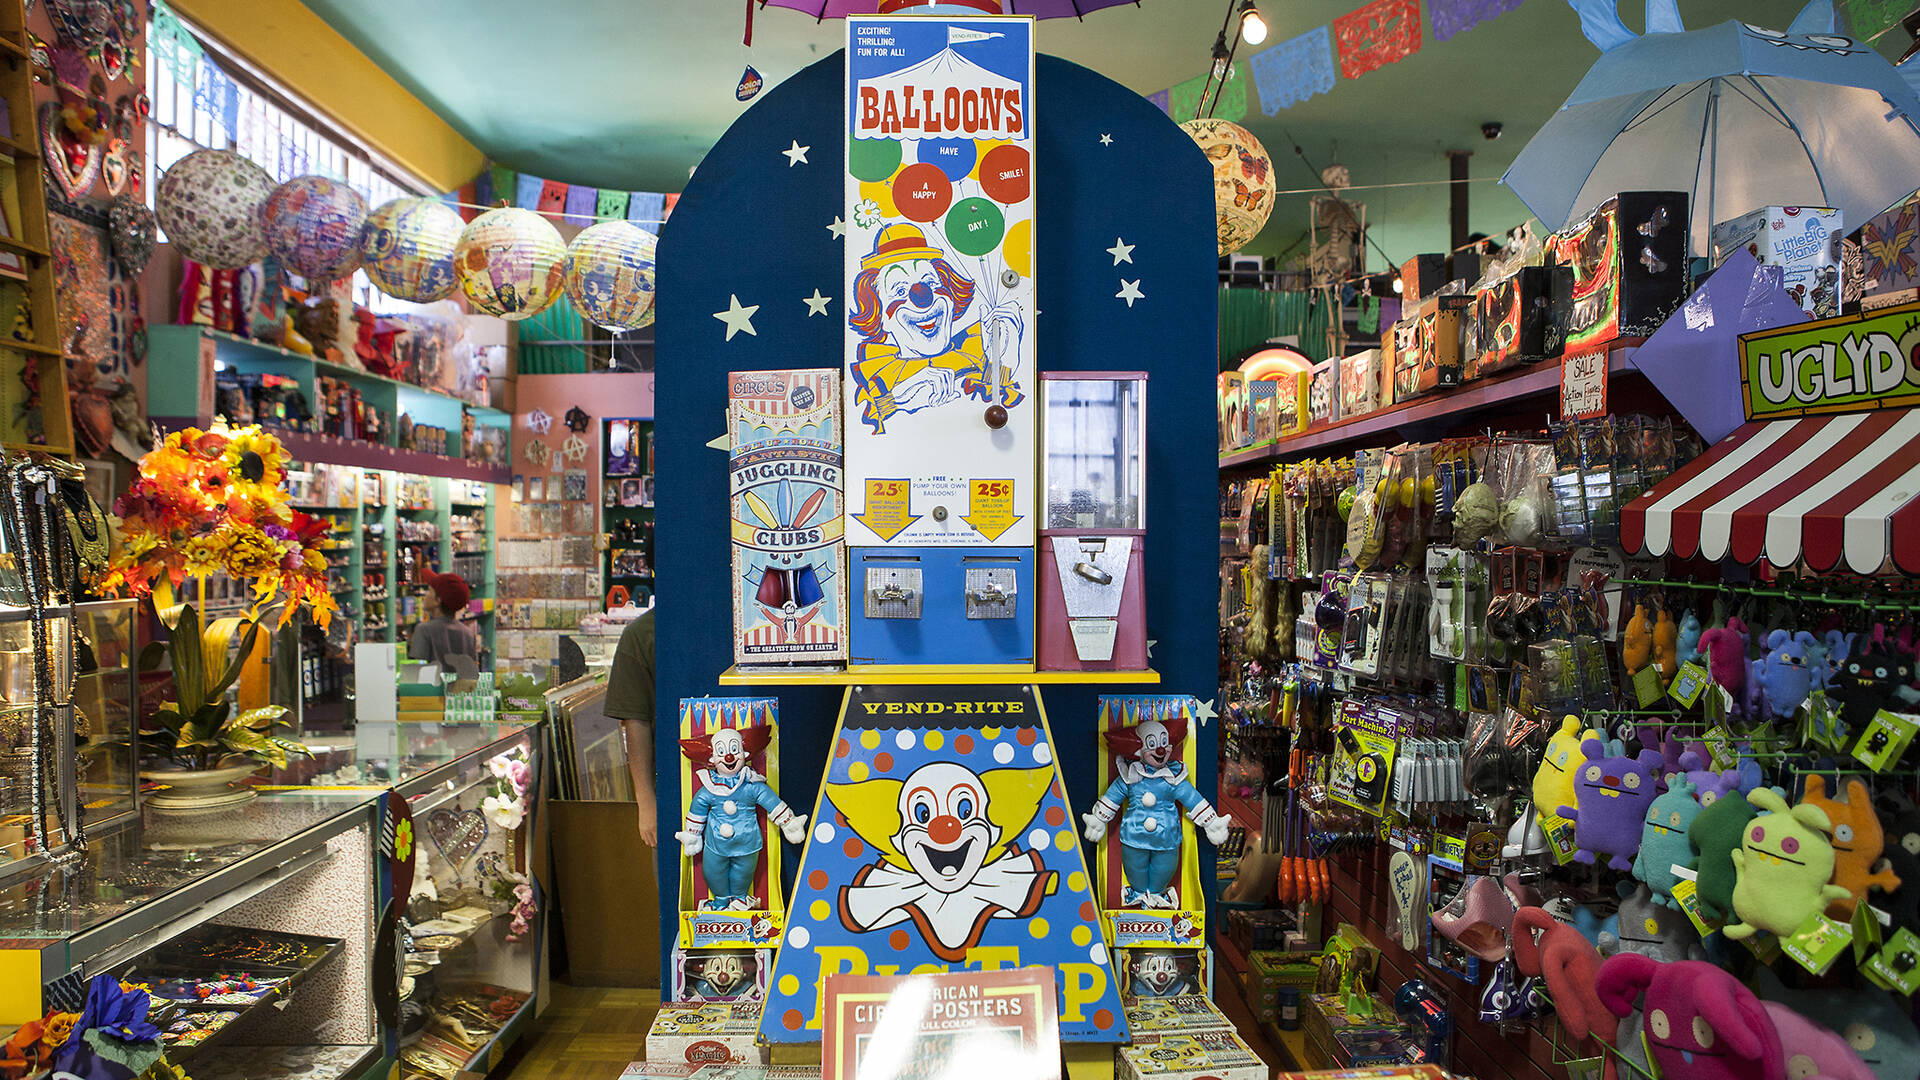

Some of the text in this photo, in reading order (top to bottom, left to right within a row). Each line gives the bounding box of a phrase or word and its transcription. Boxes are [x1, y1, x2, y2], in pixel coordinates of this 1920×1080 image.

[857, 27, 891, 35] EXCITING!
[857, 38, 895, 46] THRILLING!
[857, 48, 906, 57] FUN FOR ALL!
[860, 85, 1023, 134] BALLOONS
[939, 146, 959, 156] HAVE
[999, 168, 1024, 181] SMILE!
[923, 182, 929, 191] A
[912, 191, 937, 199] HAPPY
[1783, 241, 1824, 263] Planet
[1573, 357, 1596, 379] SALE
[733, 381, 785, 395] CIRCUS
[766, 439, 781, 447] UP
[736, 462, 837, 487] JUGGLING
[977, 482, 1010, 497] 25¢
[756, 529, 820, 546] CLUBS
[862, 701, 1025, 714] VEND-RITE
[1342, 713, 1357, 725] Fart
[1357, 718, 1388, 734] Machine
[1387, 723, 1396, 739] 2
[695, 922, 746, 935] BOZO
[1117, 921, 1166, 934] BOZO
[932, 997, 1023, 1019] POSTERS
